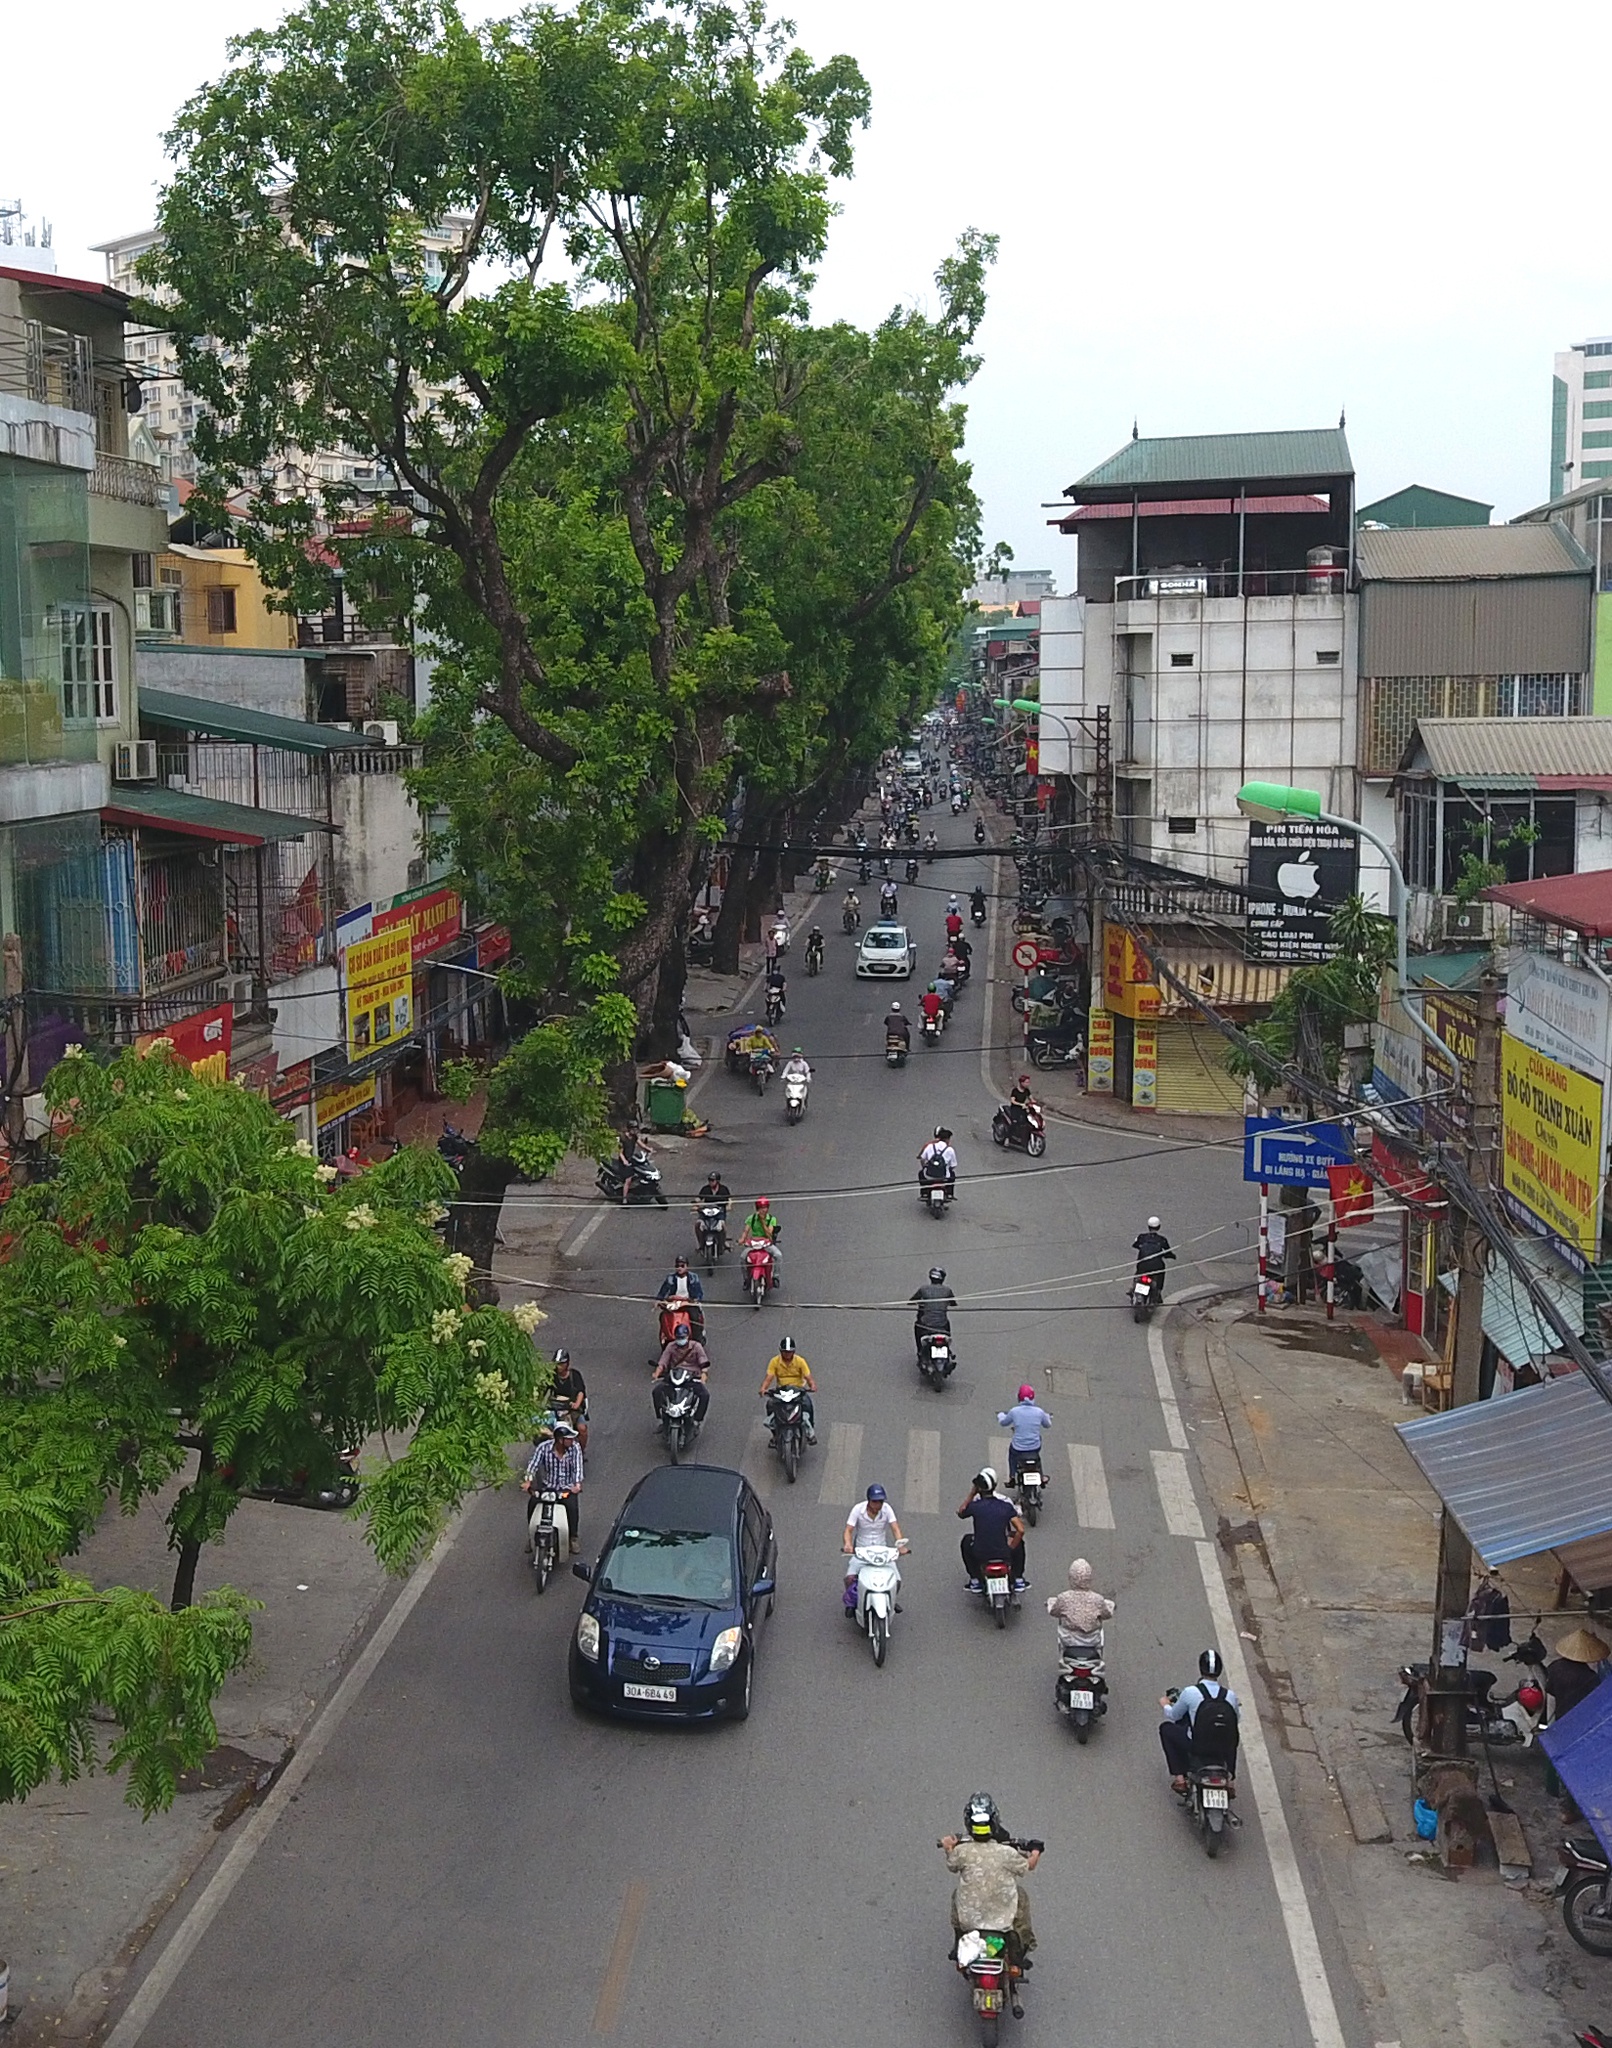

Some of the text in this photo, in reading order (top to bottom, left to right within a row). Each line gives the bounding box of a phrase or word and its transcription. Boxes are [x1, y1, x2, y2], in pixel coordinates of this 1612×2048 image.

[1266, 825, 1286, 834] PIN
[1289, 822, 1314, 835] TIẾN
[1248, 902, 1277, 916] IPHONE
[1261, 930, 1277, 939] CÁC
[1299, 932, 1314, 940] PIN
[1545, 1062, 1568, 1093] HÀNG
[1506, 1060, 1518, 1099] ĐỒ
[1519, 1066, 1531, 1109] GỖ
[1532, 1086, 1563, 1130] THANH
[1564, 1104, 1593, 1149] XUÂN
[1305, 1155, 1315, 1165] XE
[1316, 1154, 1336, 1166] BUÝT
[1264, 1165, 1273, 1175] ĐI
[1274, 1164, 1294, 1176] LÁNG
[1295, 1168, 1306, 1180] HẠ
